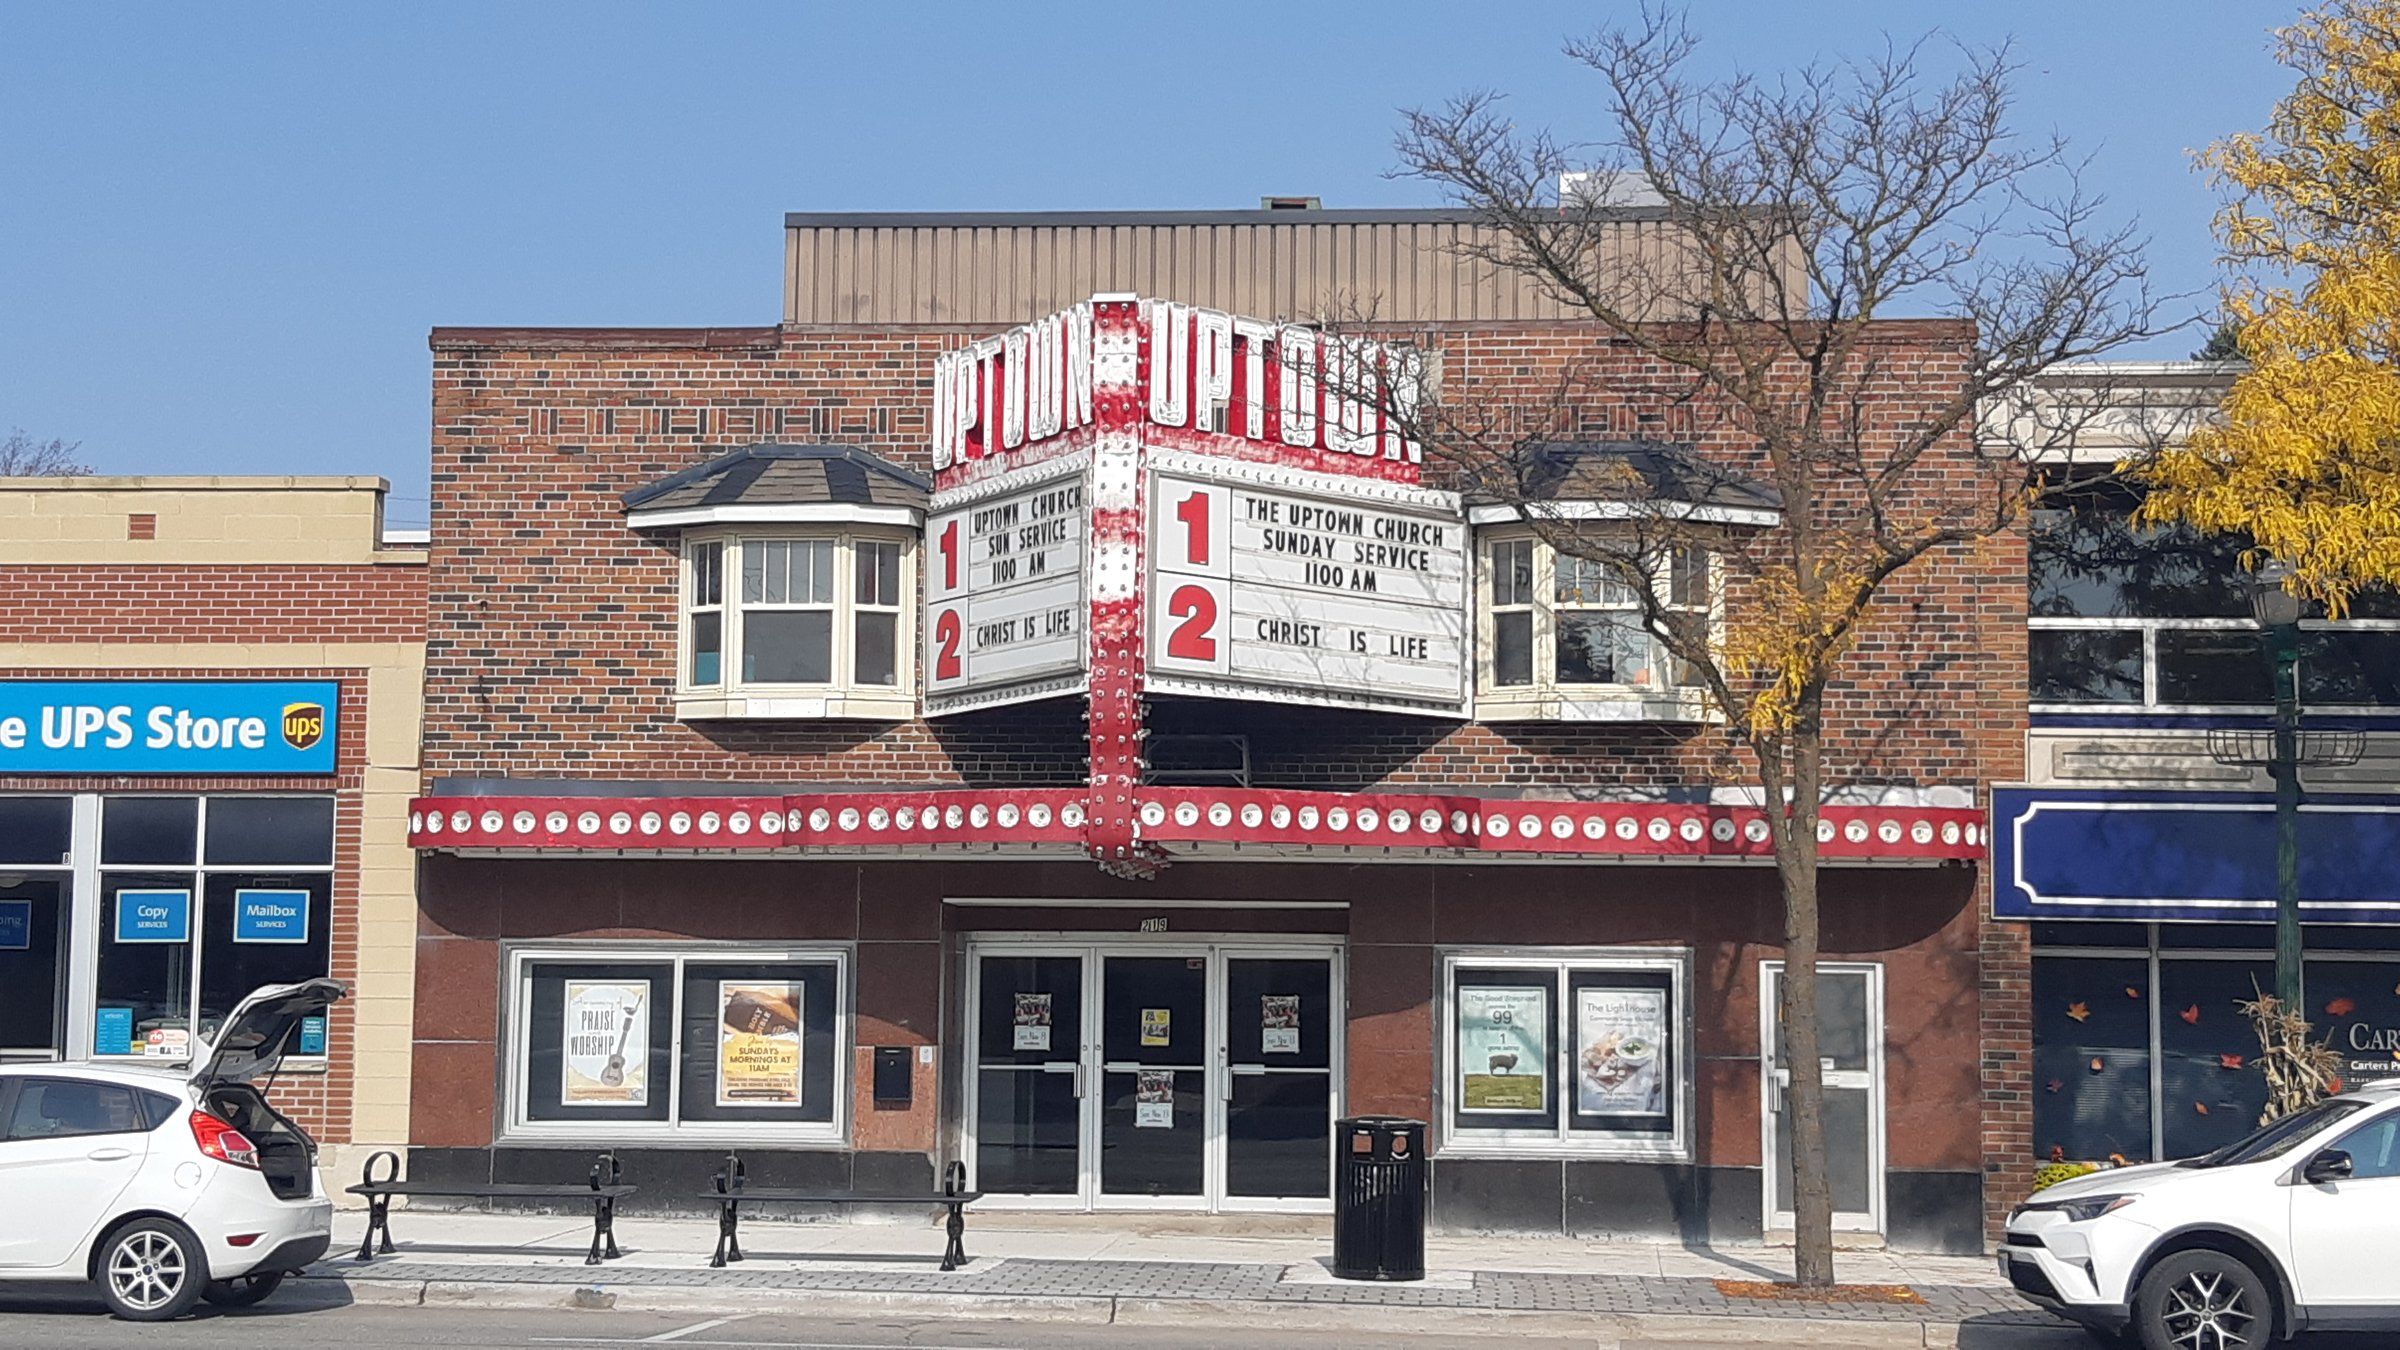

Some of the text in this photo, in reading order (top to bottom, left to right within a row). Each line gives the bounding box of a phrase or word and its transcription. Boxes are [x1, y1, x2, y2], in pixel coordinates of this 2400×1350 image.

[933, 299, 1094, 470] UPTOWN
[1149, 298, 1422, 463] UPTOWN
[975, 486, 1081, 533] UPTOWN CHURCH
[1246, 498, 1443, 547] THE UPTOWN CHURCH
[989, 518, 1066, 557] SUN SERVICE
[1177, 491, 1209, 566] 1
[940, 520, 957, 590] 1
[1264, 528, 1429, 571] SUNDAY SERVICE
[992, 551, 1045, 585] 1100 AM
[1305, 562, 1377, 592] 1100 AM
[977, 609, 1070, 647] CHRIST IS LIFE
[1168, 584, 1217, 661] 2
[1257, 619, 1428, 659] CHRIST IS LIFE
[936, 609, 961, 681] 2
[41, 705, 133, 749] UPS
[146, 705, 266, 749] Store
[284, 716, 320, 743] ups
[138, 905, 168, 918] Copy
[247, 904, 296, 917] Mailbox
[1141, 917, 1168, 933] 219
[581, 1010, 615, 1031] PRAISE
[1493, 1010, 1512, 1024] 99
[1587, 1001, 1656, 1013] The Lighthouse
[571, 1035, 615, 1056] WORSHIP
[739, 1047, 779, 1055] SUNDAYS
[1500, 1033, 1506, 1044] 1
[2350, 1022, 2400, 1050] CAR
[2351, 1061, 2388, 1070] Carters
